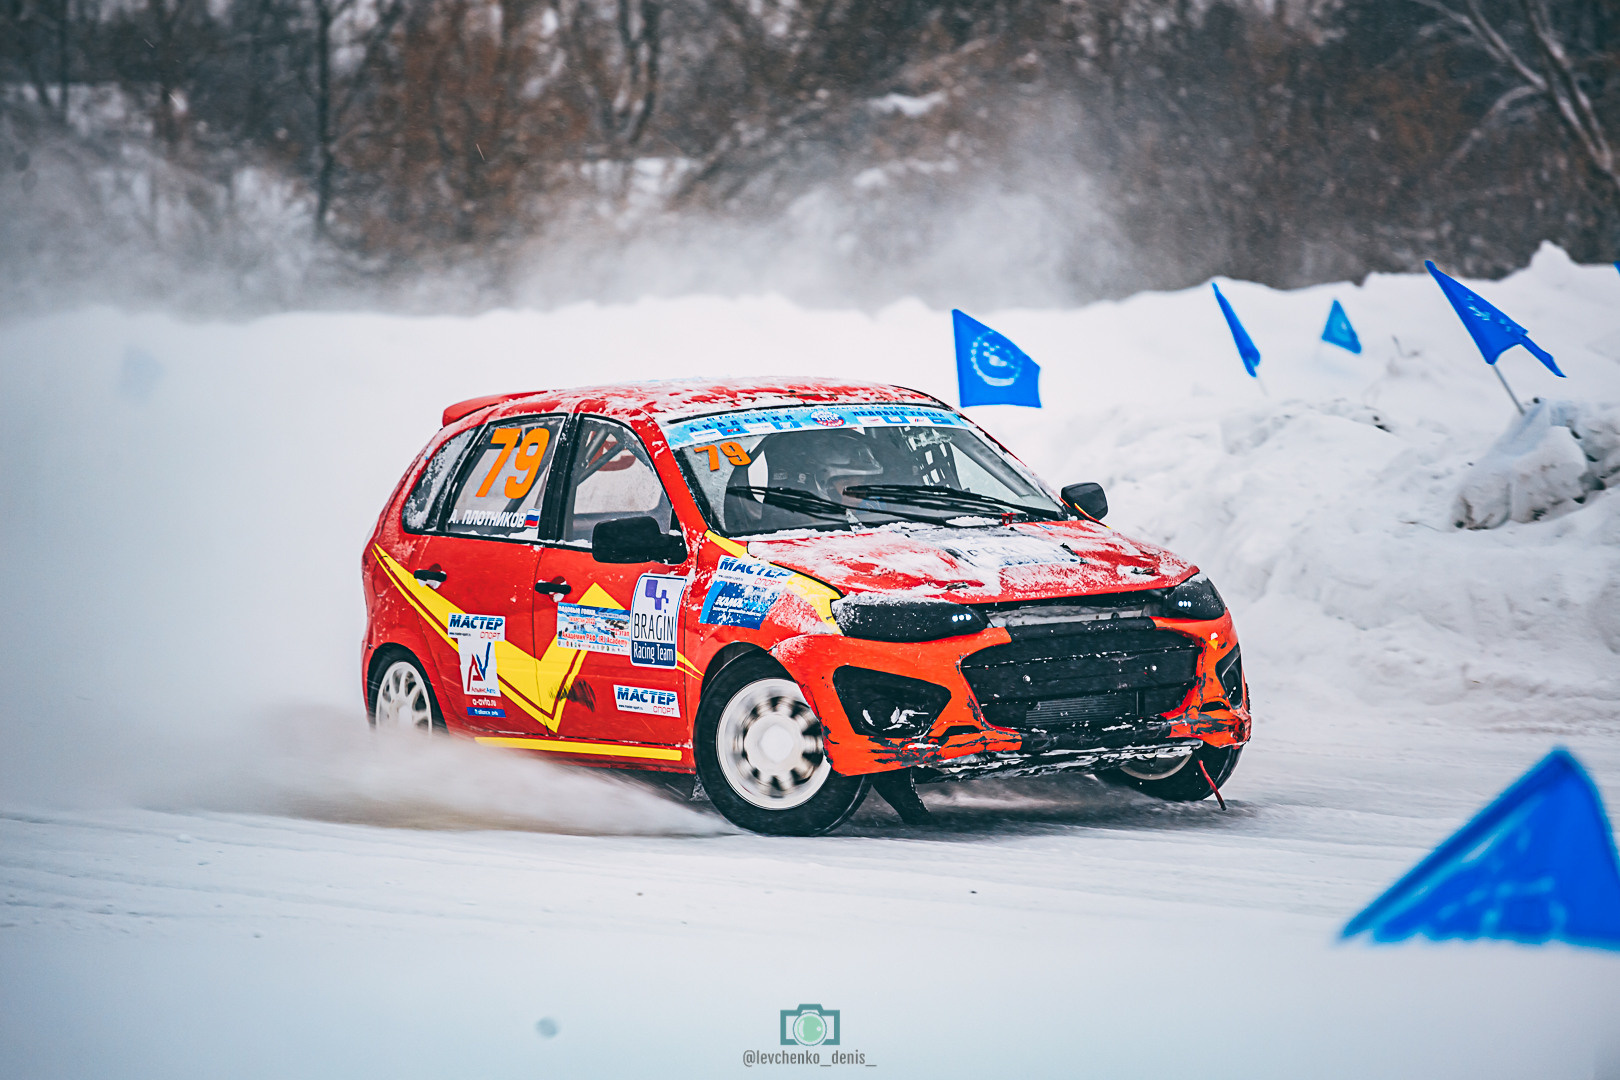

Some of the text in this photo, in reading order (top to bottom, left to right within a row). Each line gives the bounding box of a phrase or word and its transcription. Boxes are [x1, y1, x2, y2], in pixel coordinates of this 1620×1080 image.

[475, 427, 550, 499] 79
[693, 441, 751, 472] 79
[448, 508, 526, 528] А. ПЛОТНИКОВ
[449, 614, 504, 630] МАСТЕР
[634, 610, 674, 641] BRAGIN
[480, 631, 500, 640] СПОРТ
[633, 641, 655, 664] Racing
[656, 643, 674, 662] Team
[617, 687, 676, 705] МАСТЕР
[653, 705, 675, 715] СПОРТ
